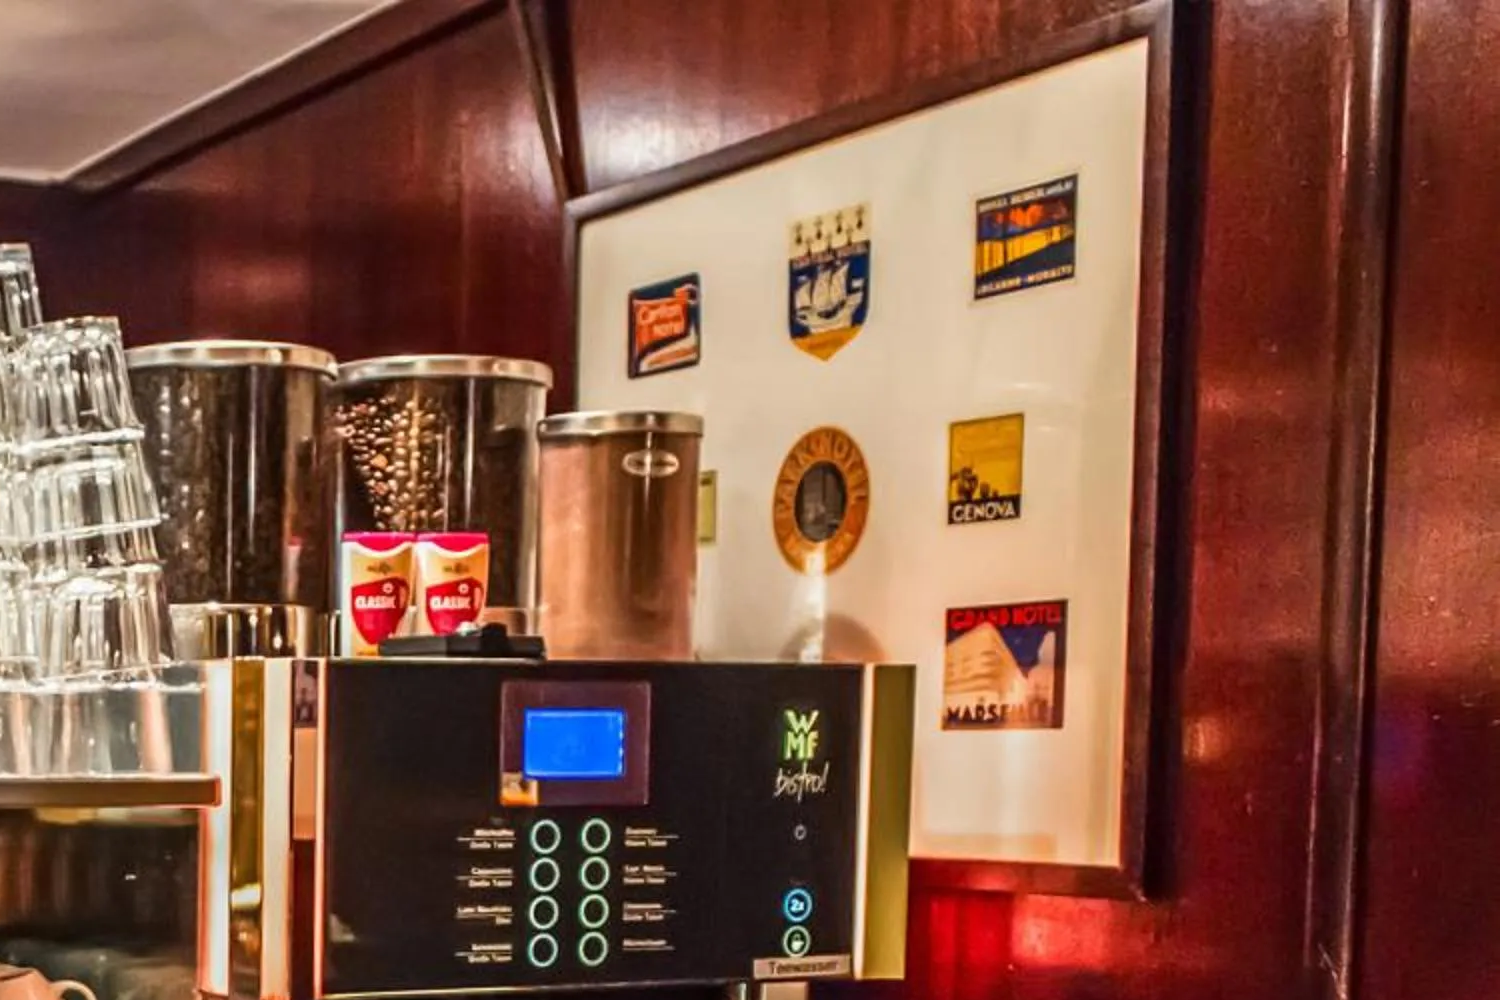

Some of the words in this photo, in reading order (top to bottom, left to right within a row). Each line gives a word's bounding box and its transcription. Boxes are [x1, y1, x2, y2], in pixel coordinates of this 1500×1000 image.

[952, 501, 1016, 521] GENOVA
[355, 595, 396, 609] CLASSIC
[429, 595, 471, 610] CLASSIC
[950, 607, 1009, 630] GRAND
[1012, 604, 1061, 626] HOTEL
[784, 709, 819, 760] WMF
[772, 761, 830, 803] bistro!
